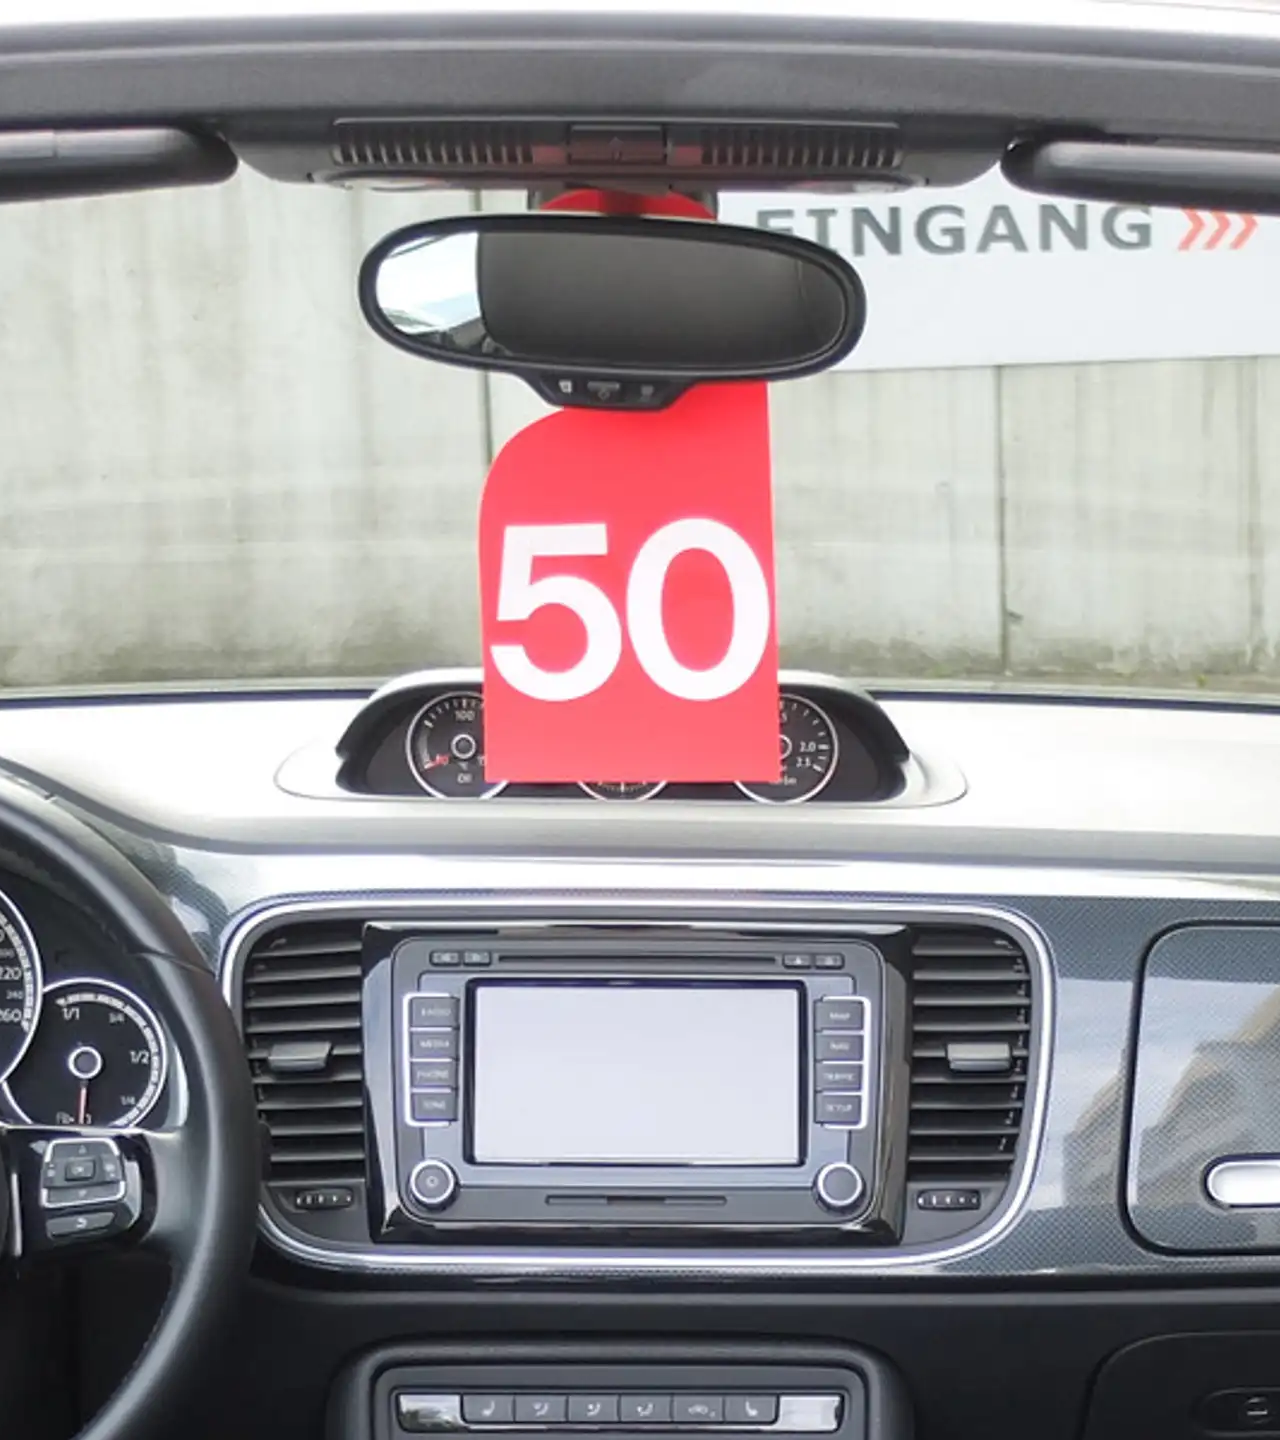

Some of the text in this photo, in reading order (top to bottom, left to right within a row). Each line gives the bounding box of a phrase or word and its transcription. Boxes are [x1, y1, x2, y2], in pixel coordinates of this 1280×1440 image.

[489, 517, 770, 702] 50
[62, 1007, 80, 1021] 1/1
[130, 1050, 150, 1065] 1/2
